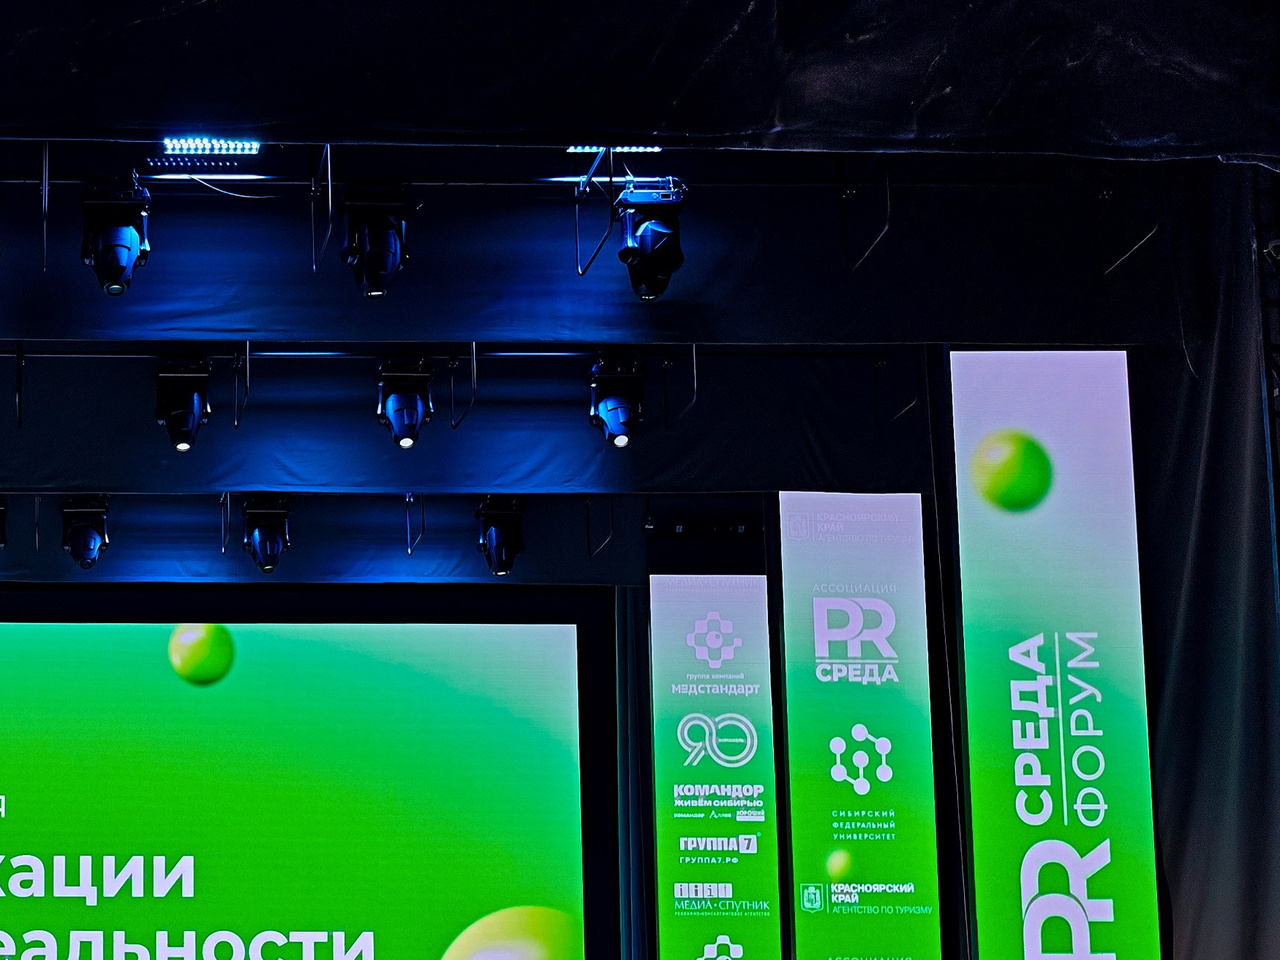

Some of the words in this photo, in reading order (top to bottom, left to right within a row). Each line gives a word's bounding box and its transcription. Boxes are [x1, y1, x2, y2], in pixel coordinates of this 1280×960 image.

[812, 584, 897, 594] АССОЦИАЦИЯ
[812, 597, 899, 658] PR
[815, 663, 899, 685] СРЕДА
[1009, 633, 1058, 826] СРЕДА
[1066, 632, 1108, 827] ФОРУМ
[673, 784, 764, 798] КОМАНДОР
[832, 809, 895, 817] СИБИРСКИЙ
[832, 820, 896, 829] ФЕДЕРАЛЬНЫЙ
[680, 837, 738, 850] ГРУППА
[831, 882, 914, 893] КРАСНОЯРСКИЙ
[832, 893, 859, 903] КРАЙ
[833, 906, 879, 914] АГЕНТСТВО
[881, 906, 893, 914] ПО
[896, 906, 932, 914] ТУРИЗМУ
